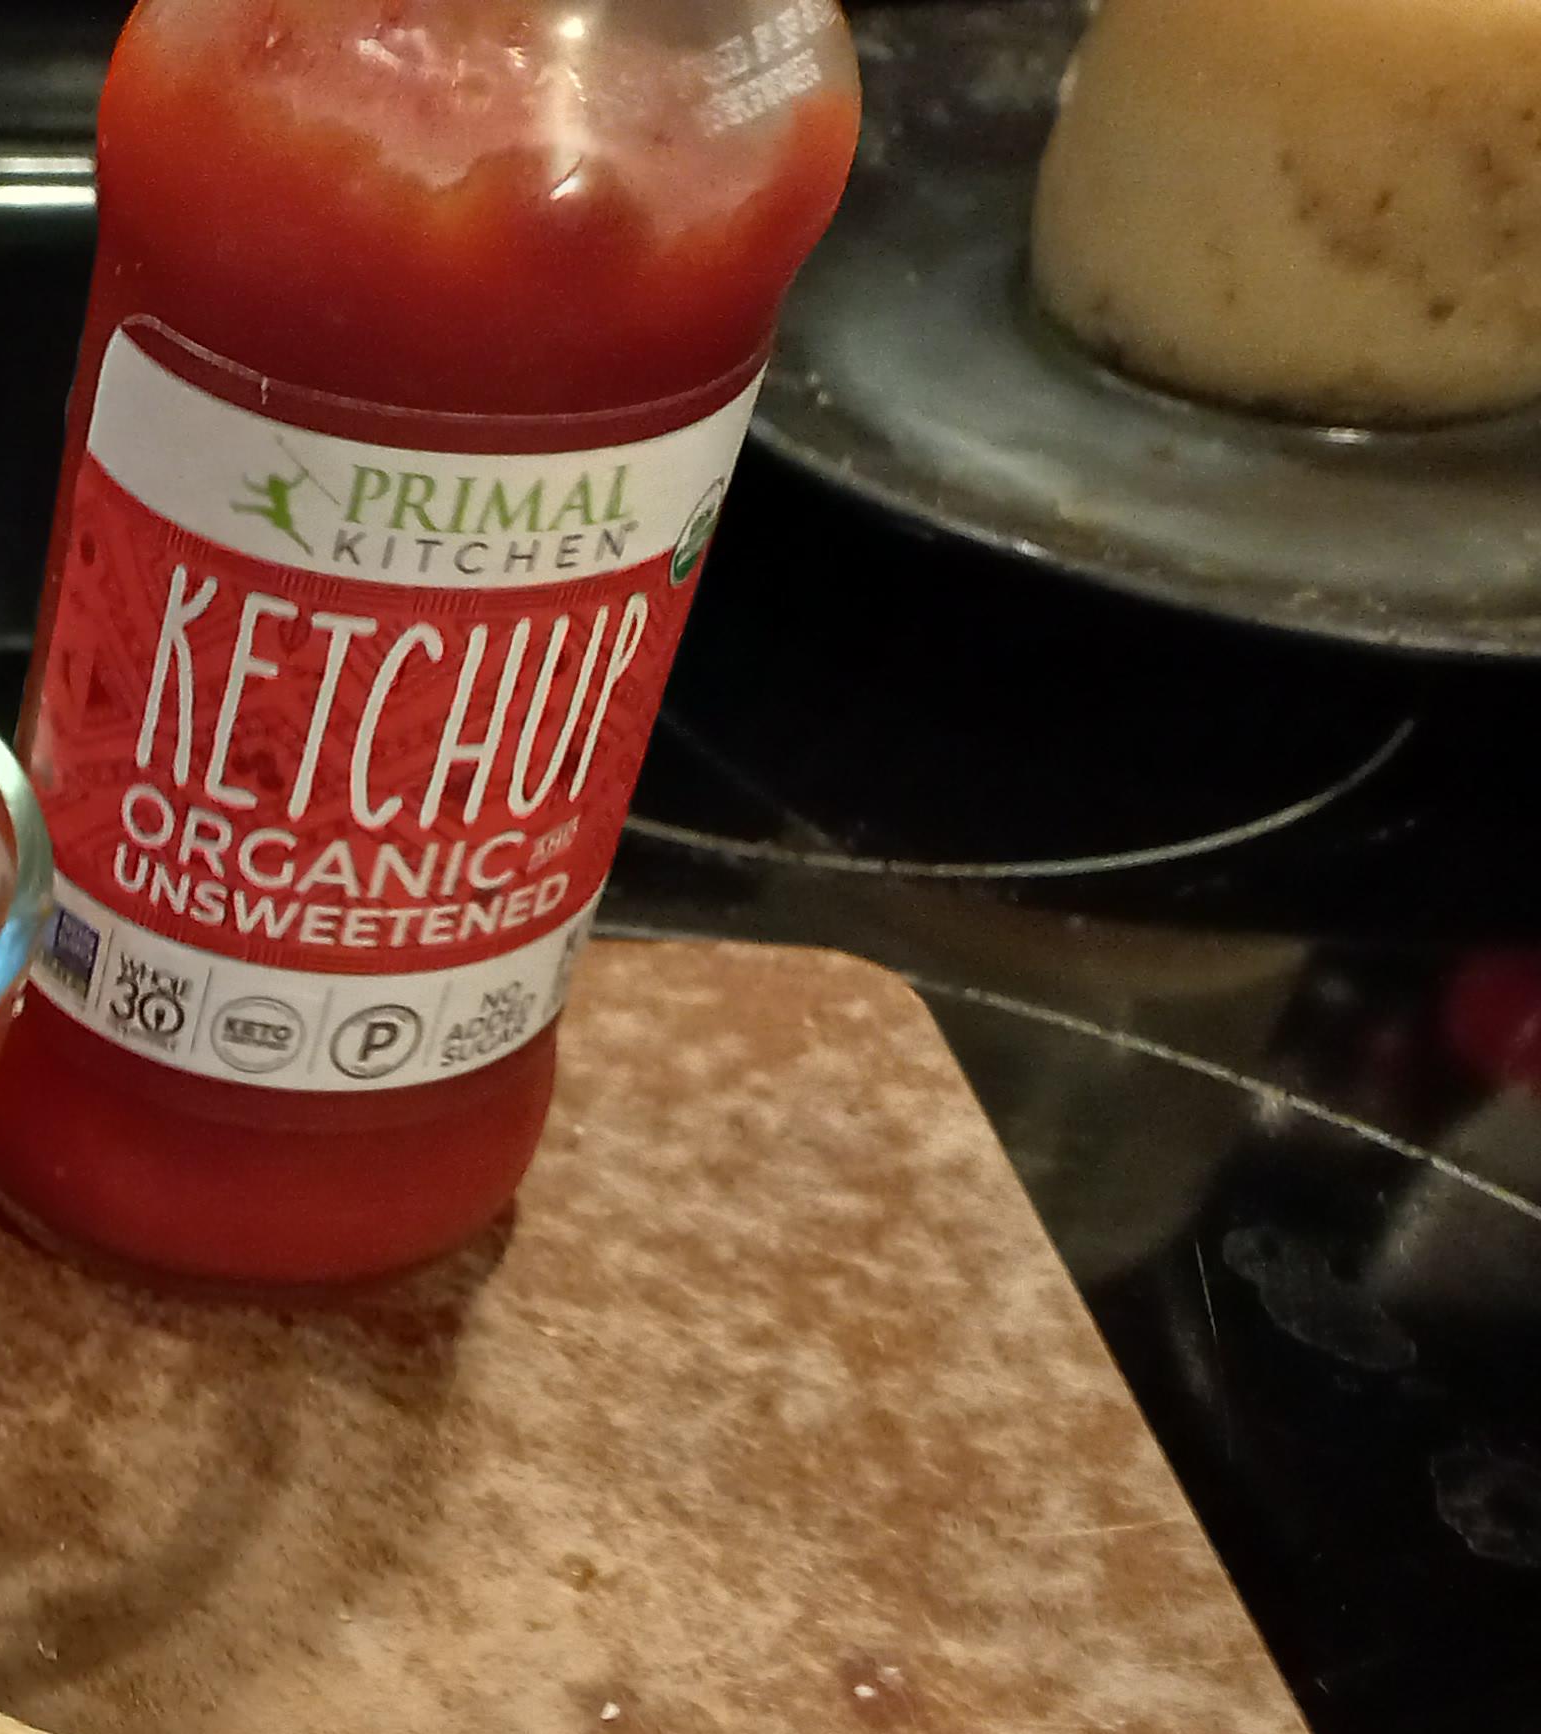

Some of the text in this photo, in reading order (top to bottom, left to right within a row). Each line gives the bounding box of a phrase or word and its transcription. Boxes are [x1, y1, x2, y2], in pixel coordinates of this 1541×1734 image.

[344, 463, 637, 534] PRIMAL
[332, 527, 627, 575] KITCHEN
[134, 562, 649, 829] KETCHUP
[119, 782, 527, 900] ORGANIC
[113, 841, 571, 948] UNSWEETENED
[358, 1021, 400, 1062] P
